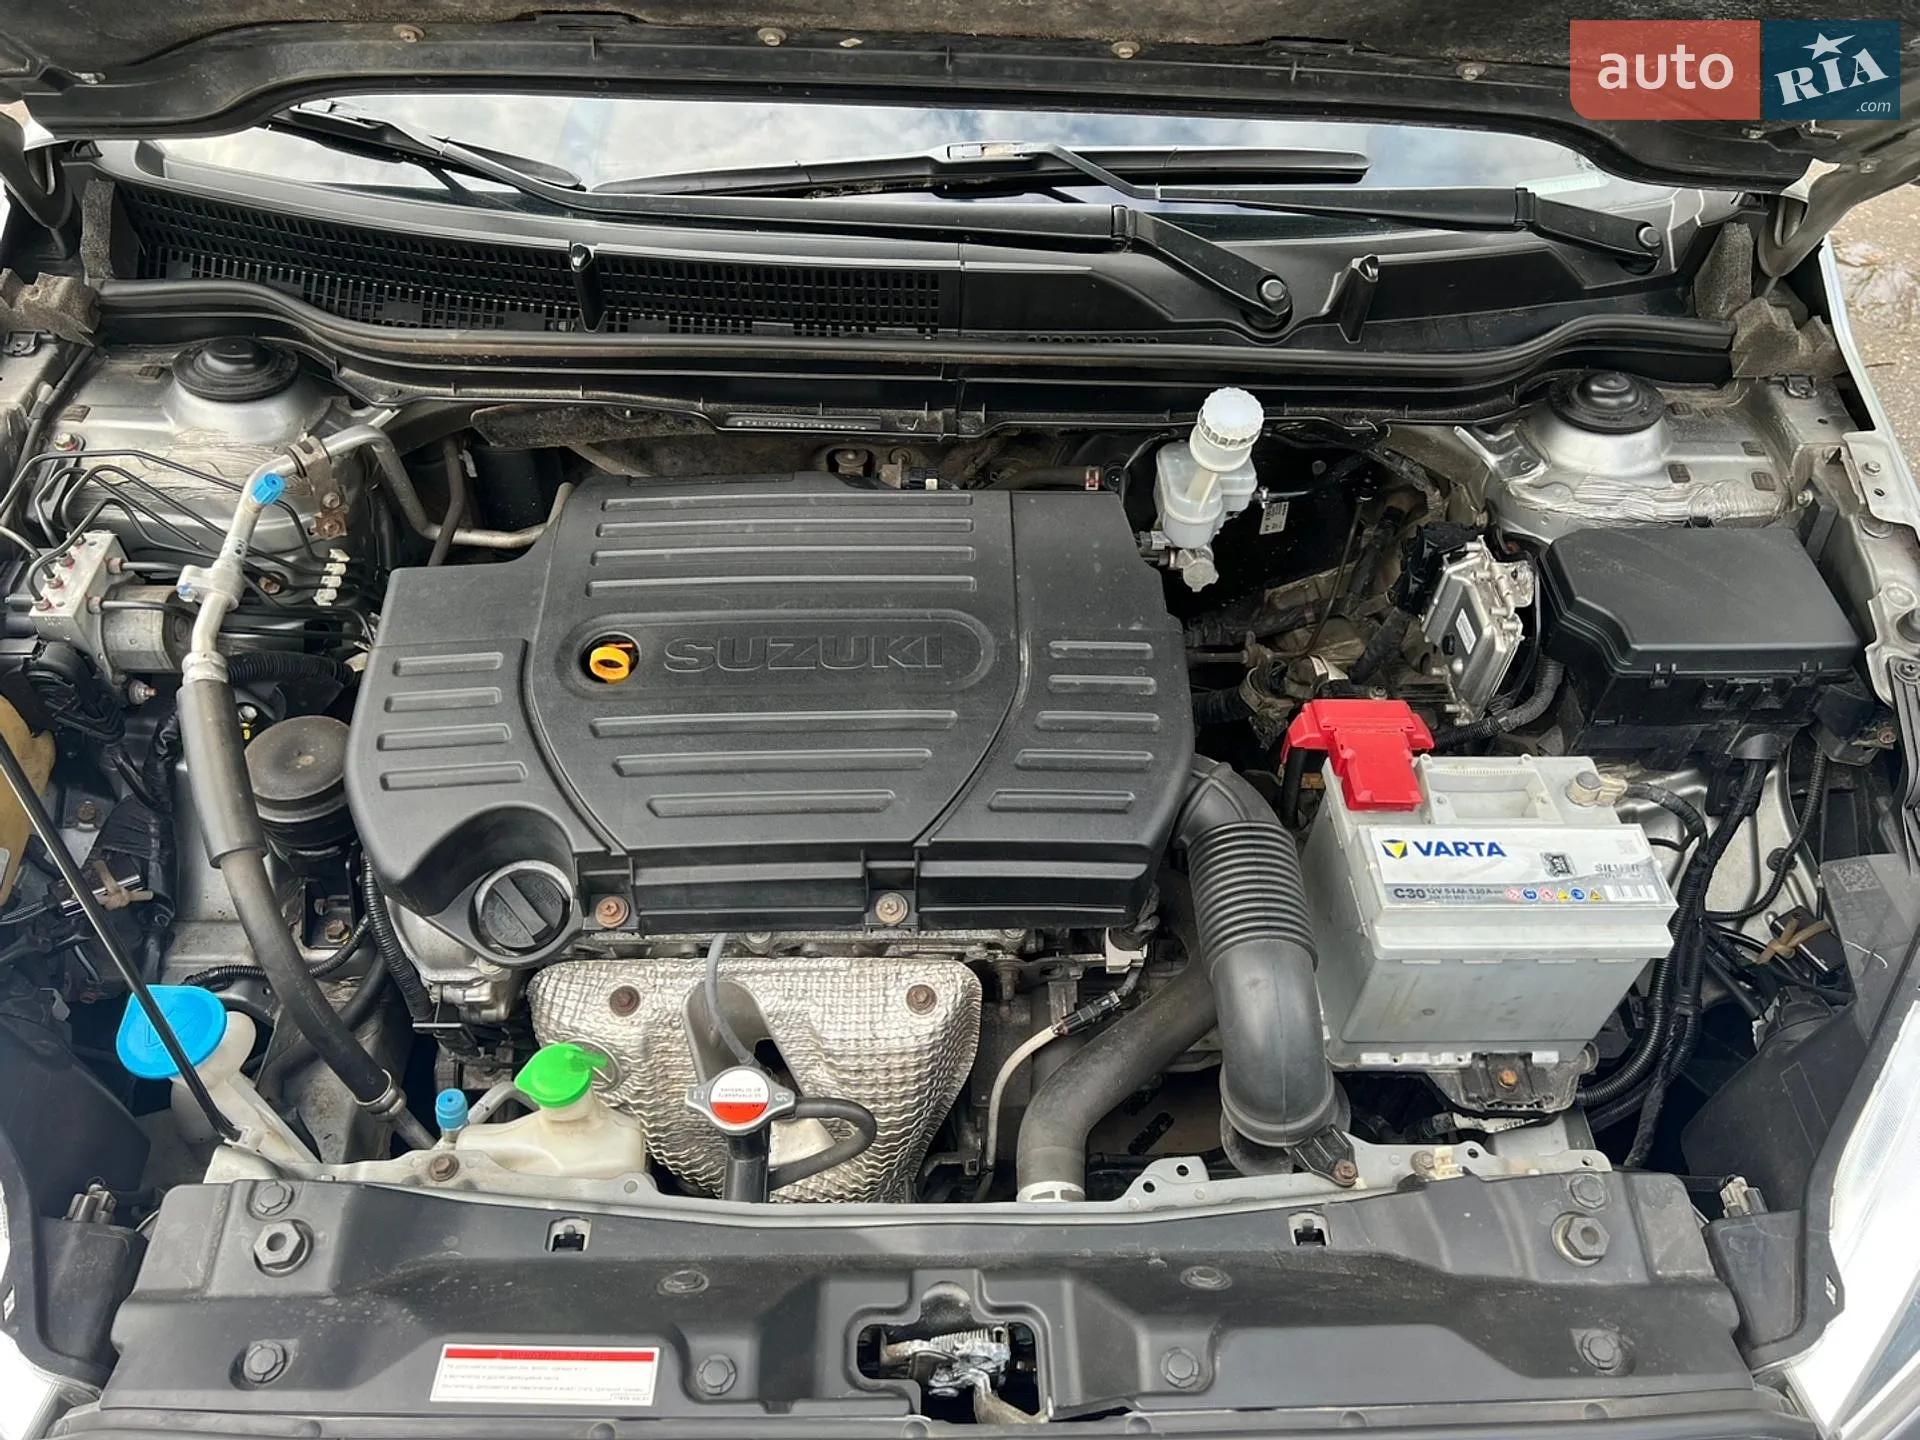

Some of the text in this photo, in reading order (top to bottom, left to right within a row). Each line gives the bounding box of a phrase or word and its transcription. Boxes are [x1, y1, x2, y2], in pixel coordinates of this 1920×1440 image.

[663, 635, 943, 673] SUZUKI
[1412, 840, 1508, 858] VARTA
[1393, 887, 1426, 899] C30
